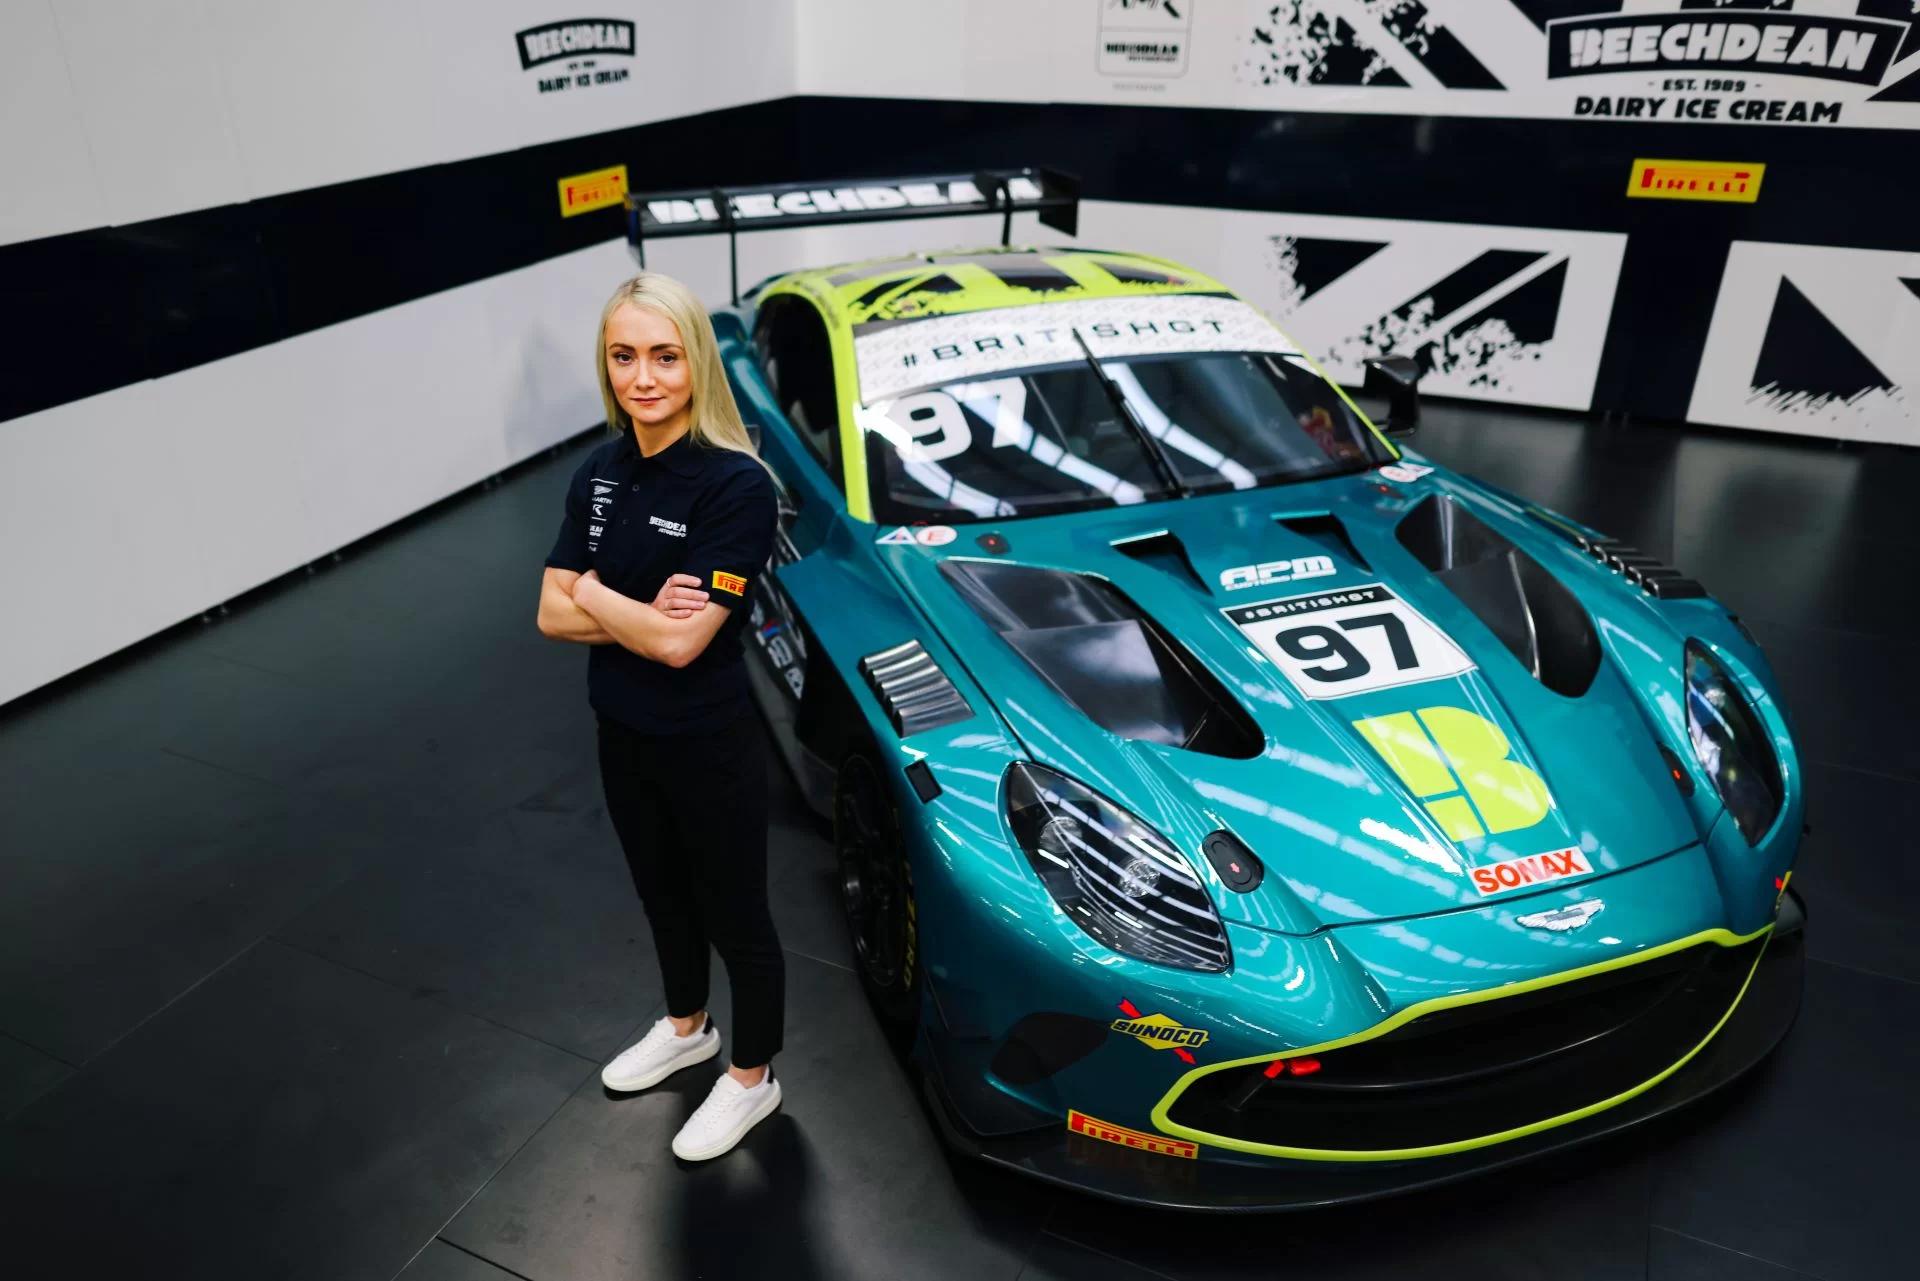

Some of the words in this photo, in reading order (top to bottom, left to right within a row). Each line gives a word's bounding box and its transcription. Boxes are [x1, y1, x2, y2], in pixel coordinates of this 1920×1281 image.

[1569, 23, 1877, 72] BEECHDEAN
[1662, 79, 1697, 91] EST.
[1703, 79, 1746, 92] 1989
[1574, 97, 1666, 117] DAIRY
[1674, 98, 1720, 119] ICE
[1728, 101, 1842, 123] CREAM
[1641, 168, 1751, 193] PIRELLI
[887, 376, 1027, 463] 97
[1275, 612, 1420, 683] 97
[1473, 850, 1585, 893] SONAX
[1114, 1020, 1207, 1047] SUNOCO
[1070, 1111, 1196, 1158] PIRELLI
